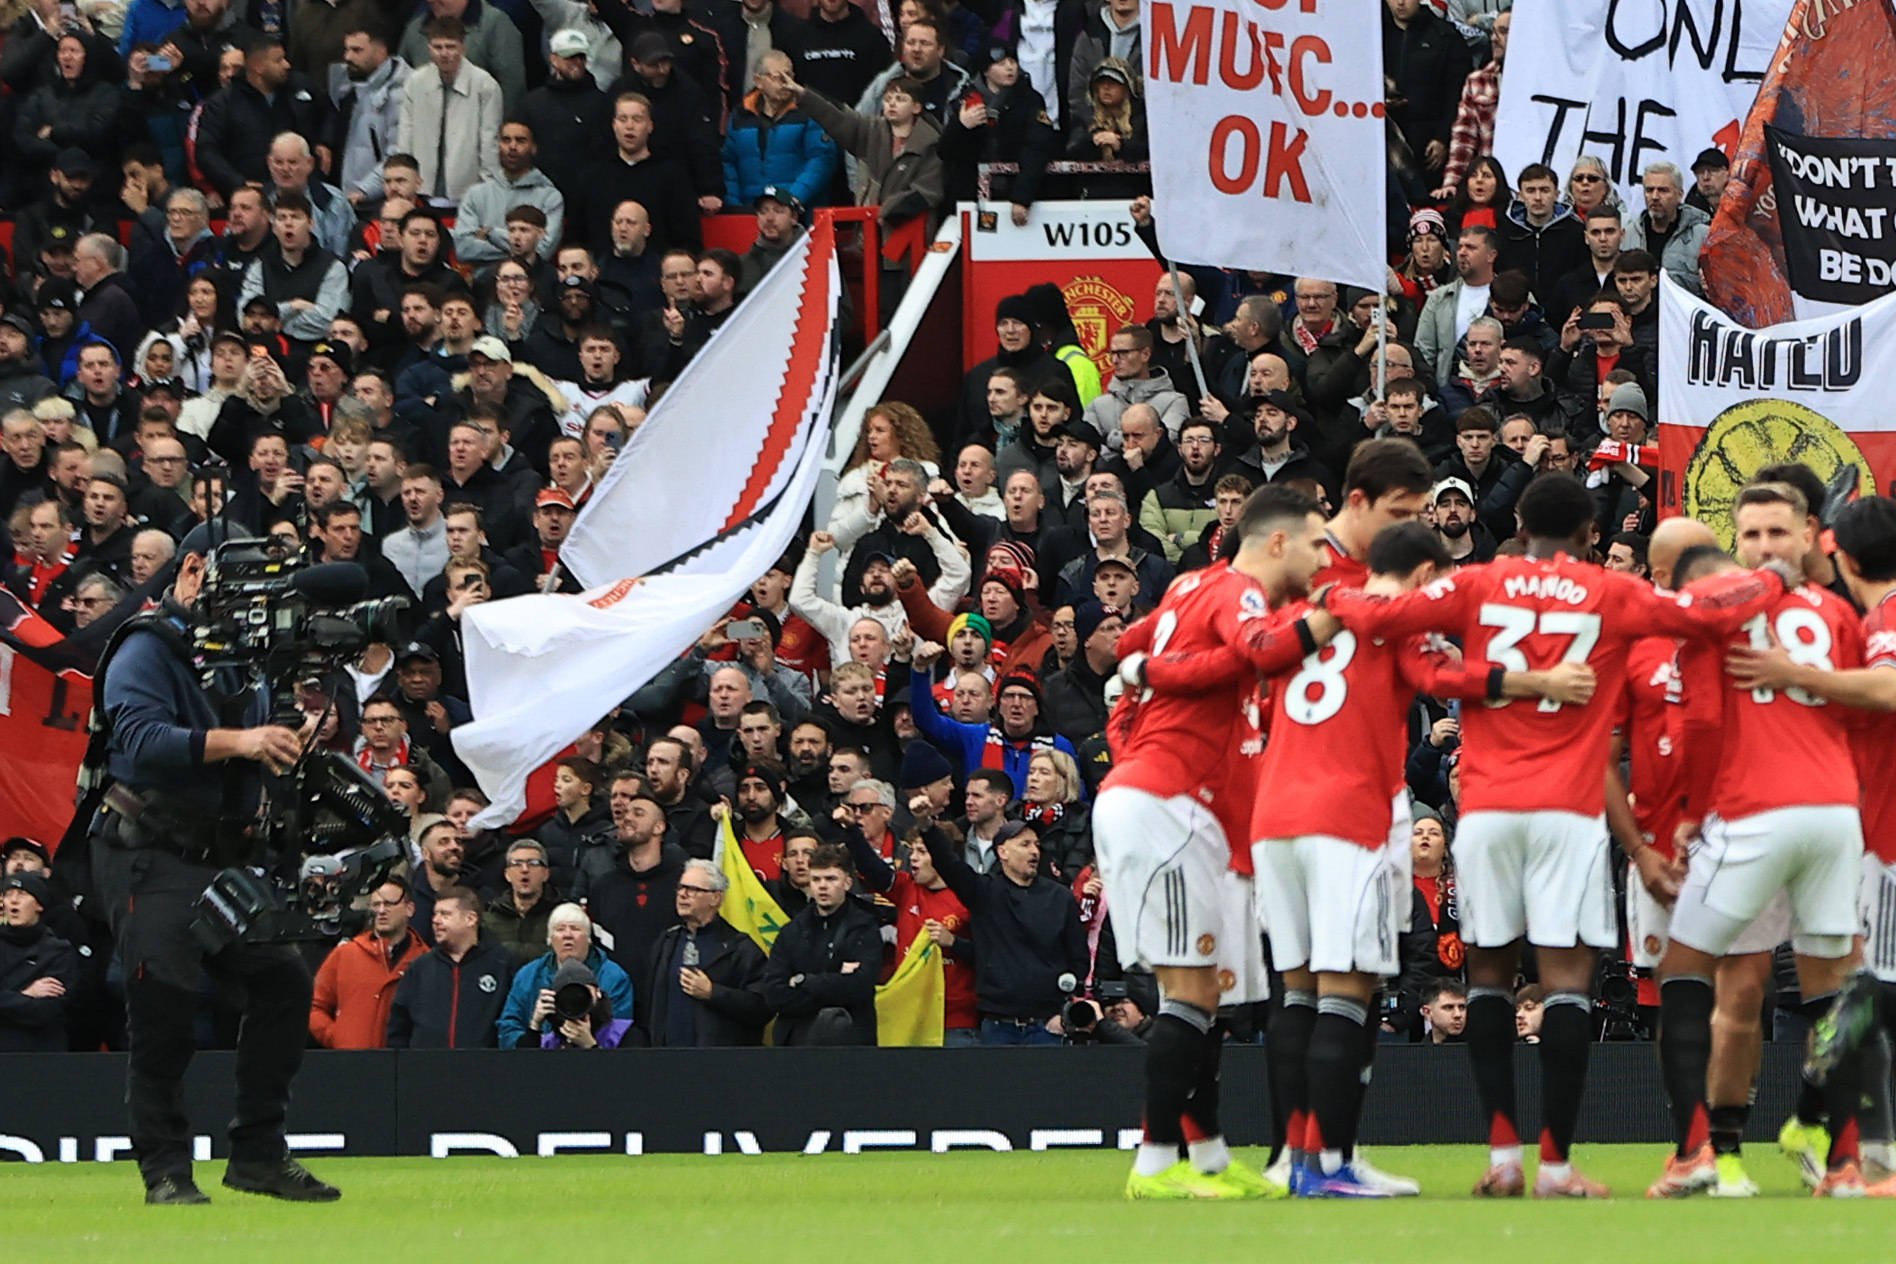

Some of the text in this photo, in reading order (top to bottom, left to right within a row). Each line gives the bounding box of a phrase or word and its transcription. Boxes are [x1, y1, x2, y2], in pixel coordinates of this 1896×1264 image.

[1208, 114, 1314, 204] OK
[1530, 94, 1678, 185] THE
[1043, 222, 1132, 247] W105
[1793, 194, 1887, 239] WHAT
[1063, 283, 1127, 318] NCHESTER
[1818, 248, 1863, 285] BE
[1284, 629, 1358, 726] 8
[1479, 602, 1603, 713] 37
[1741, 607, 1835, 706] 18
